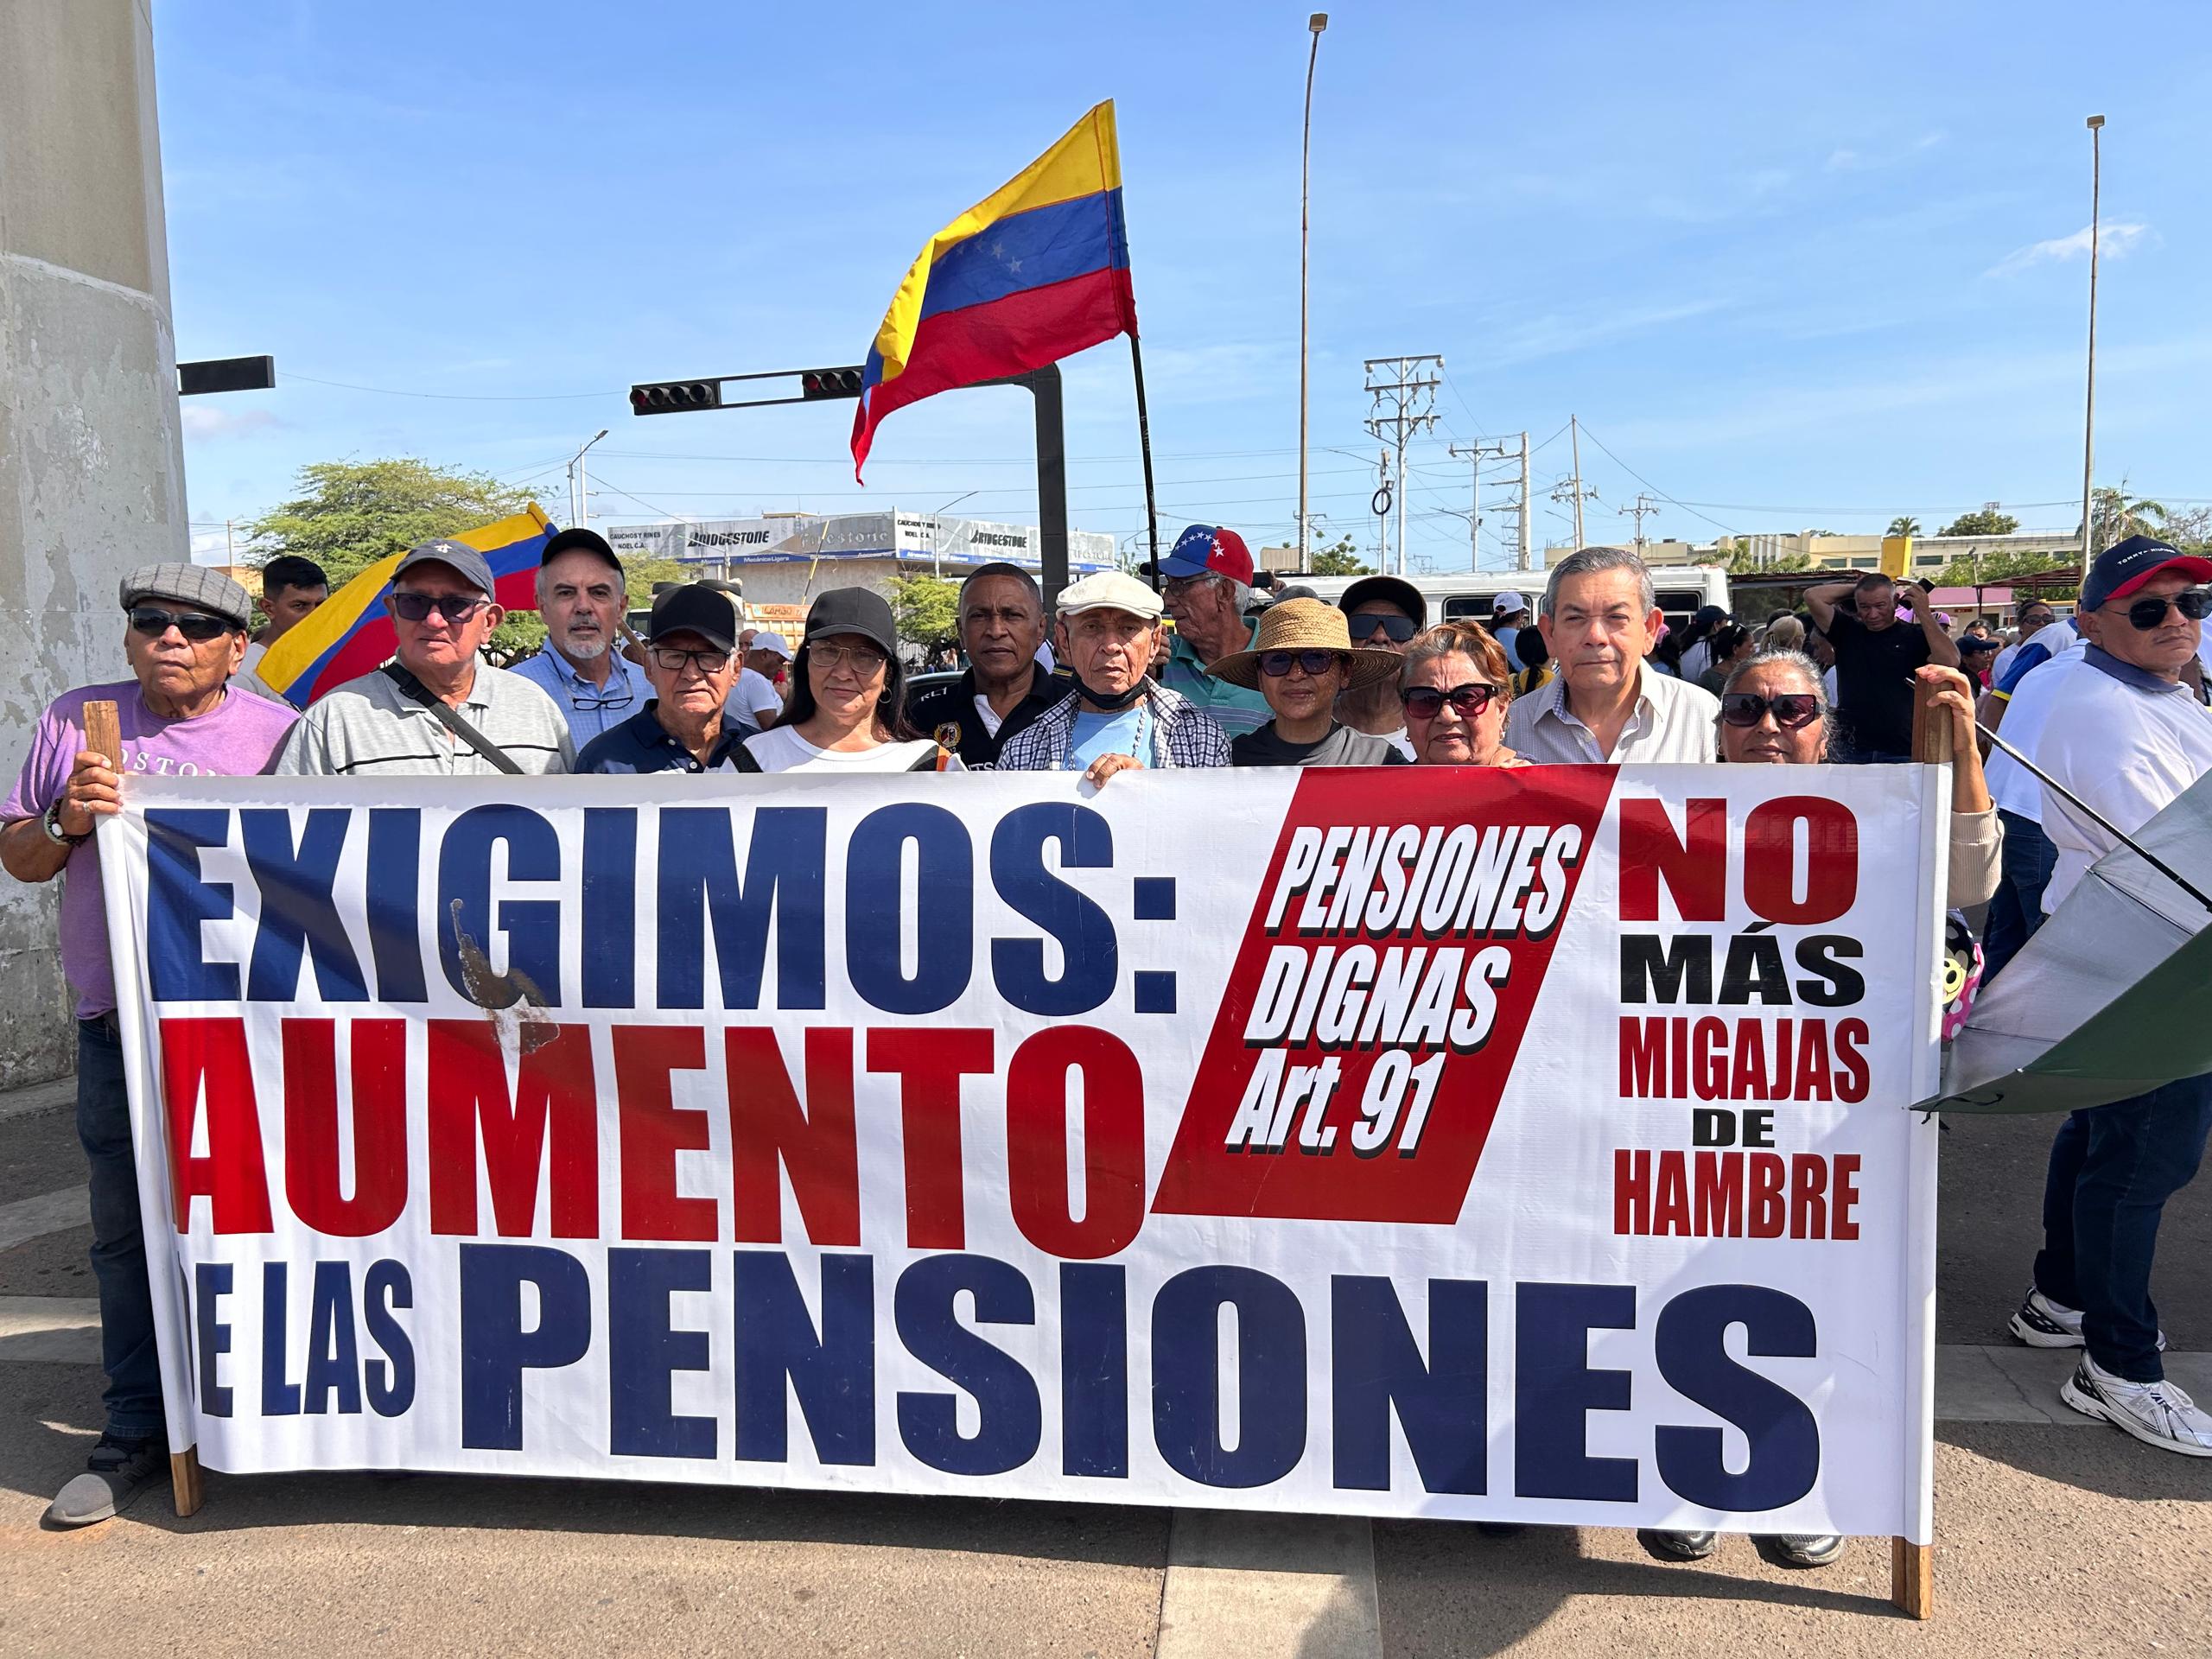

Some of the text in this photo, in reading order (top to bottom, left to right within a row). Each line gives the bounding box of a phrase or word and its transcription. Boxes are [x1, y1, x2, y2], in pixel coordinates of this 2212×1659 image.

[687, 531, 770, 547] BRIDGESTONE
[970, 530, 1027, 547] BRIDGESTONE
[2117, 551, 2143, 565] TOMMY
[146, 803, 1176, 1016] EXIGIMOS:
[1263, 823, 1583, 941] PENSIONES
[1619, 796, 1858, 925] NO
[1243, 944, 1512, 1055] DIGNAS
[1619, 921, 1866, 1007] MÁS
[1224, 1048, 1447, 1159] Art. 91
[1619, 1016, 1870, 1103] MIGAJAS
[160, 1017, 1145, 1259] AUMENTO
[1693, 1108, 1775, 1148] DE
[1614, 1149, 1861, 1241] HAMBRE
[177, 1244, 1820, 1511] E LAS PENSIONES
